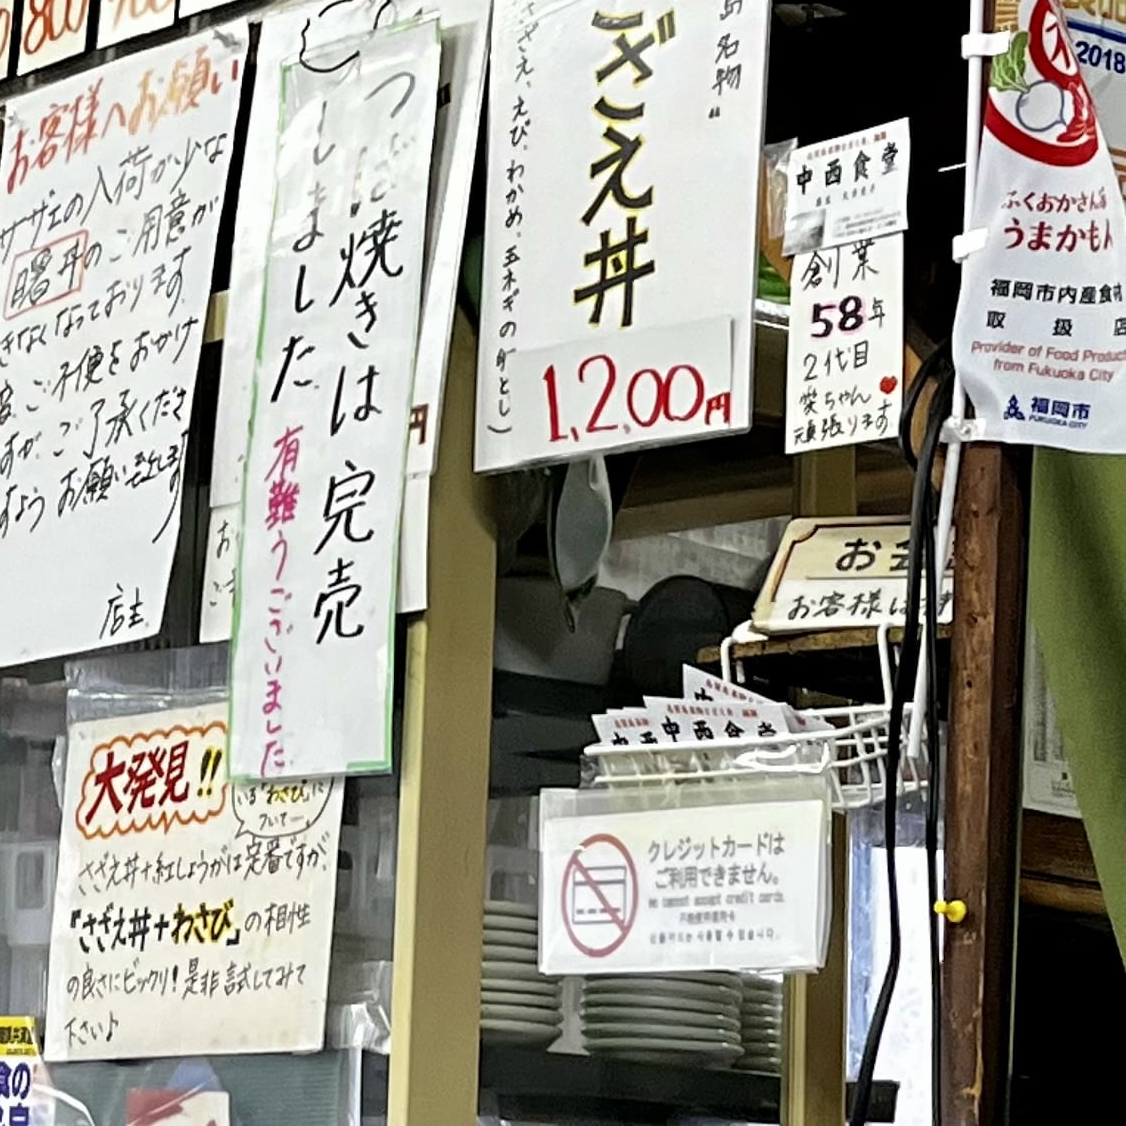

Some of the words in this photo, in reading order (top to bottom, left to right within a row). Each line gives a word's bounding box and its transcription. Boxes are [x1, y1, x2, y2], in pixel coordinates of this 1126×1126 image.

[796, 141, 899, 195] 中西食堂
[800, 239, 880, 292] 創業
[810, 294, 886, 339] 58年
[803, 340, 870, 382] 2代目
[971, 341, 1024, 354] Provider
[1028, 345, 1042, 358] of
[1046, 346, 1079, 361] Food
[993, 358, 1024, 372] from
[1028, 362, 1085, 380] Fukuoka
[1089, 368, 1115, 383] City
[1031, 396, 1091, 420] 福岡市
[98, 583, 144, 640] 店主
[648, 831, 785, 863] クレジットカードは
